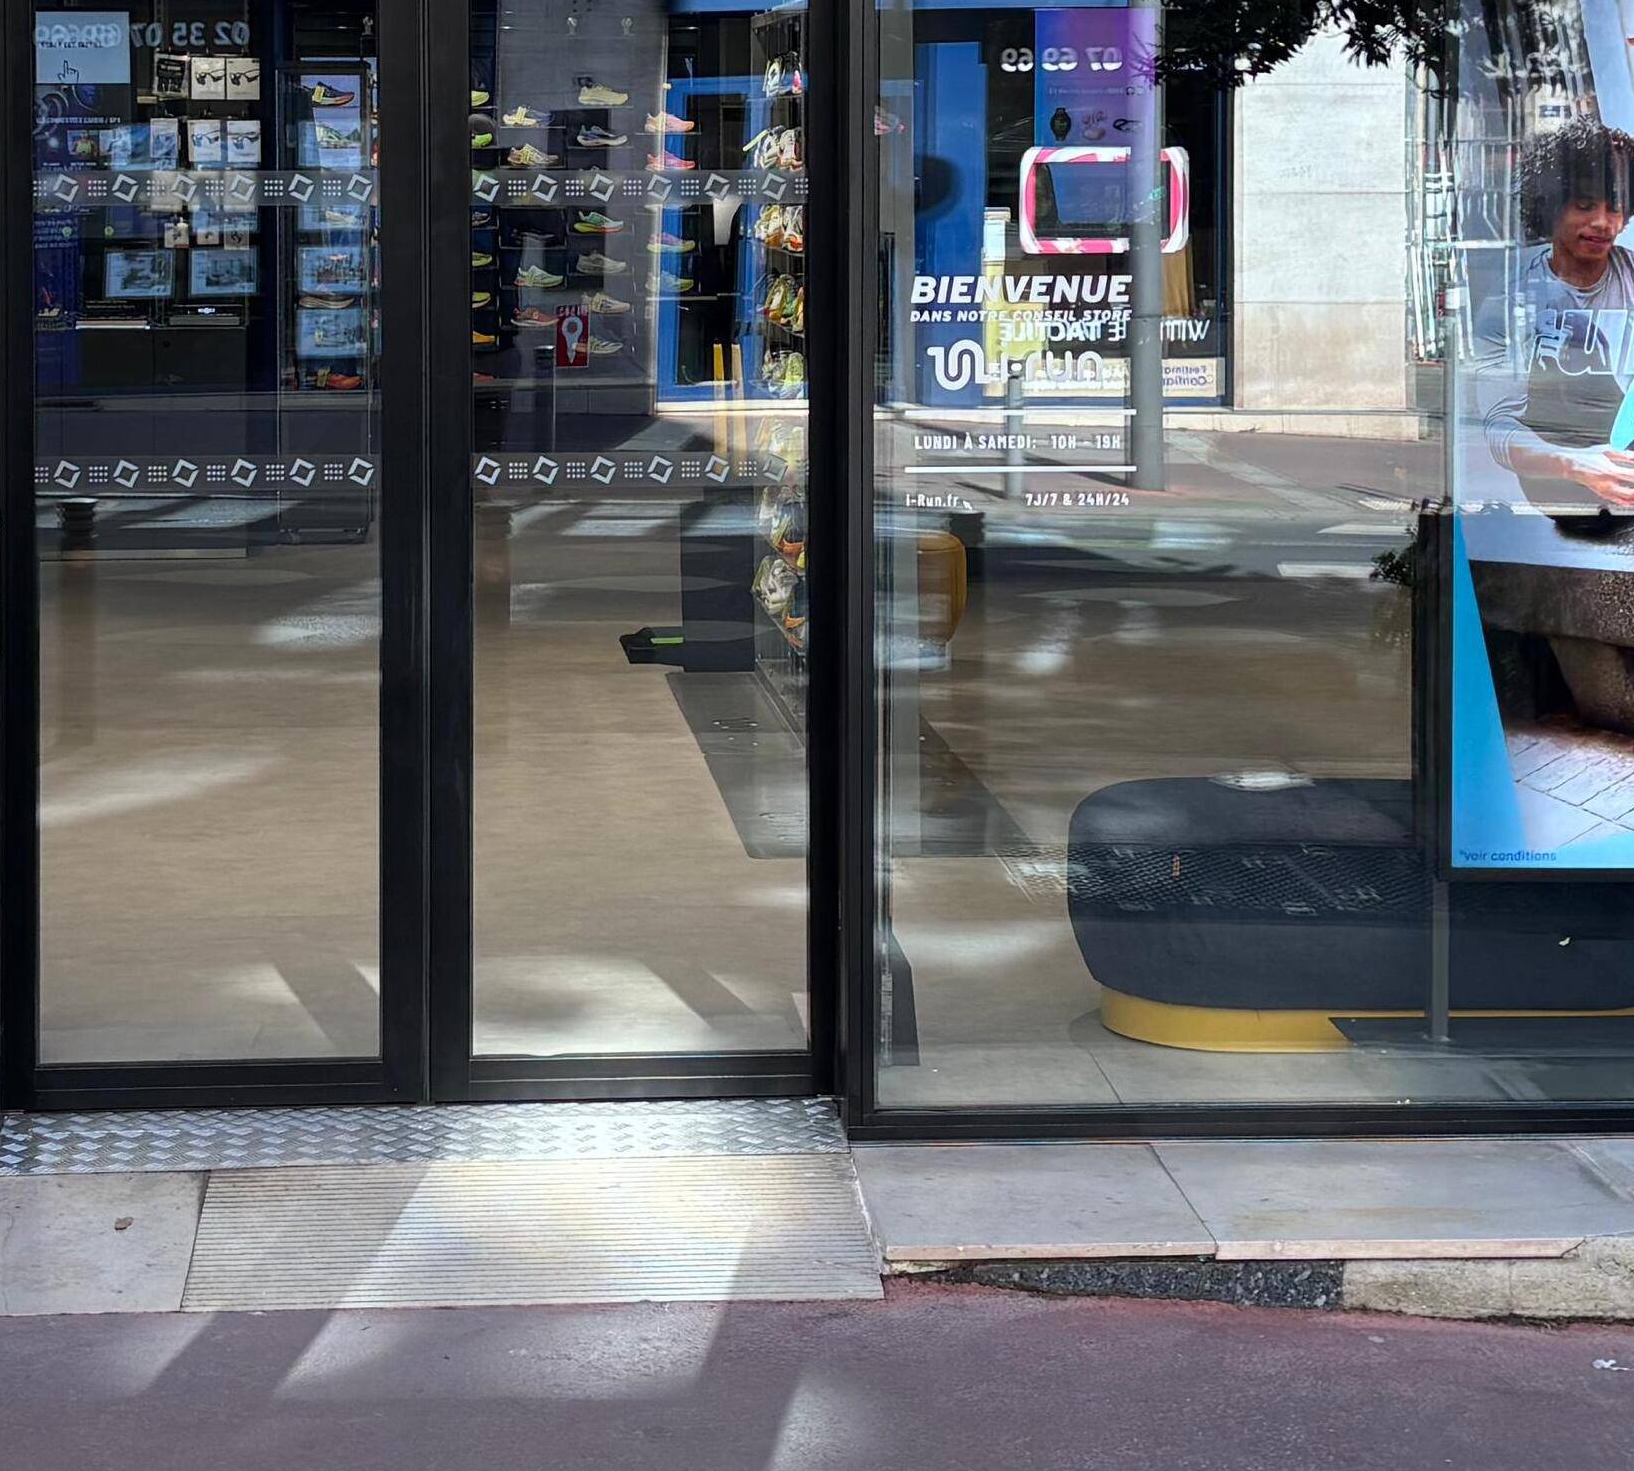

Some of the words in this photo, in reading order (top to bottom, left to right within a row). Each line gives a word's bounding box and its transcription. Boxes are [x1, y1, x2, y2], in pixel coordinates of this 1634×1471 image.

[910, 275, 1132, 304] BIENVENUE
[910, 310, 951, 322] DANS
[956, 310, 1006, 322] NOTRE
[1012, 309, 1077, 322] CONSEIL
[1082, 309, 1131, 322] STORE
[914, 435, 957, 450] LUNDI
[964, 432, 974, 450] À
[978, 435, 1037, 450] SAMEDI:
[1050, 435, 1076, 450] 10H
[1095, 435, 1121, 450] 19H
[1025, 493, 1058, 507] 7J/7
[1062, 493, 1073, 506] &
[1077, 493, 1130, 507] 24H/24
